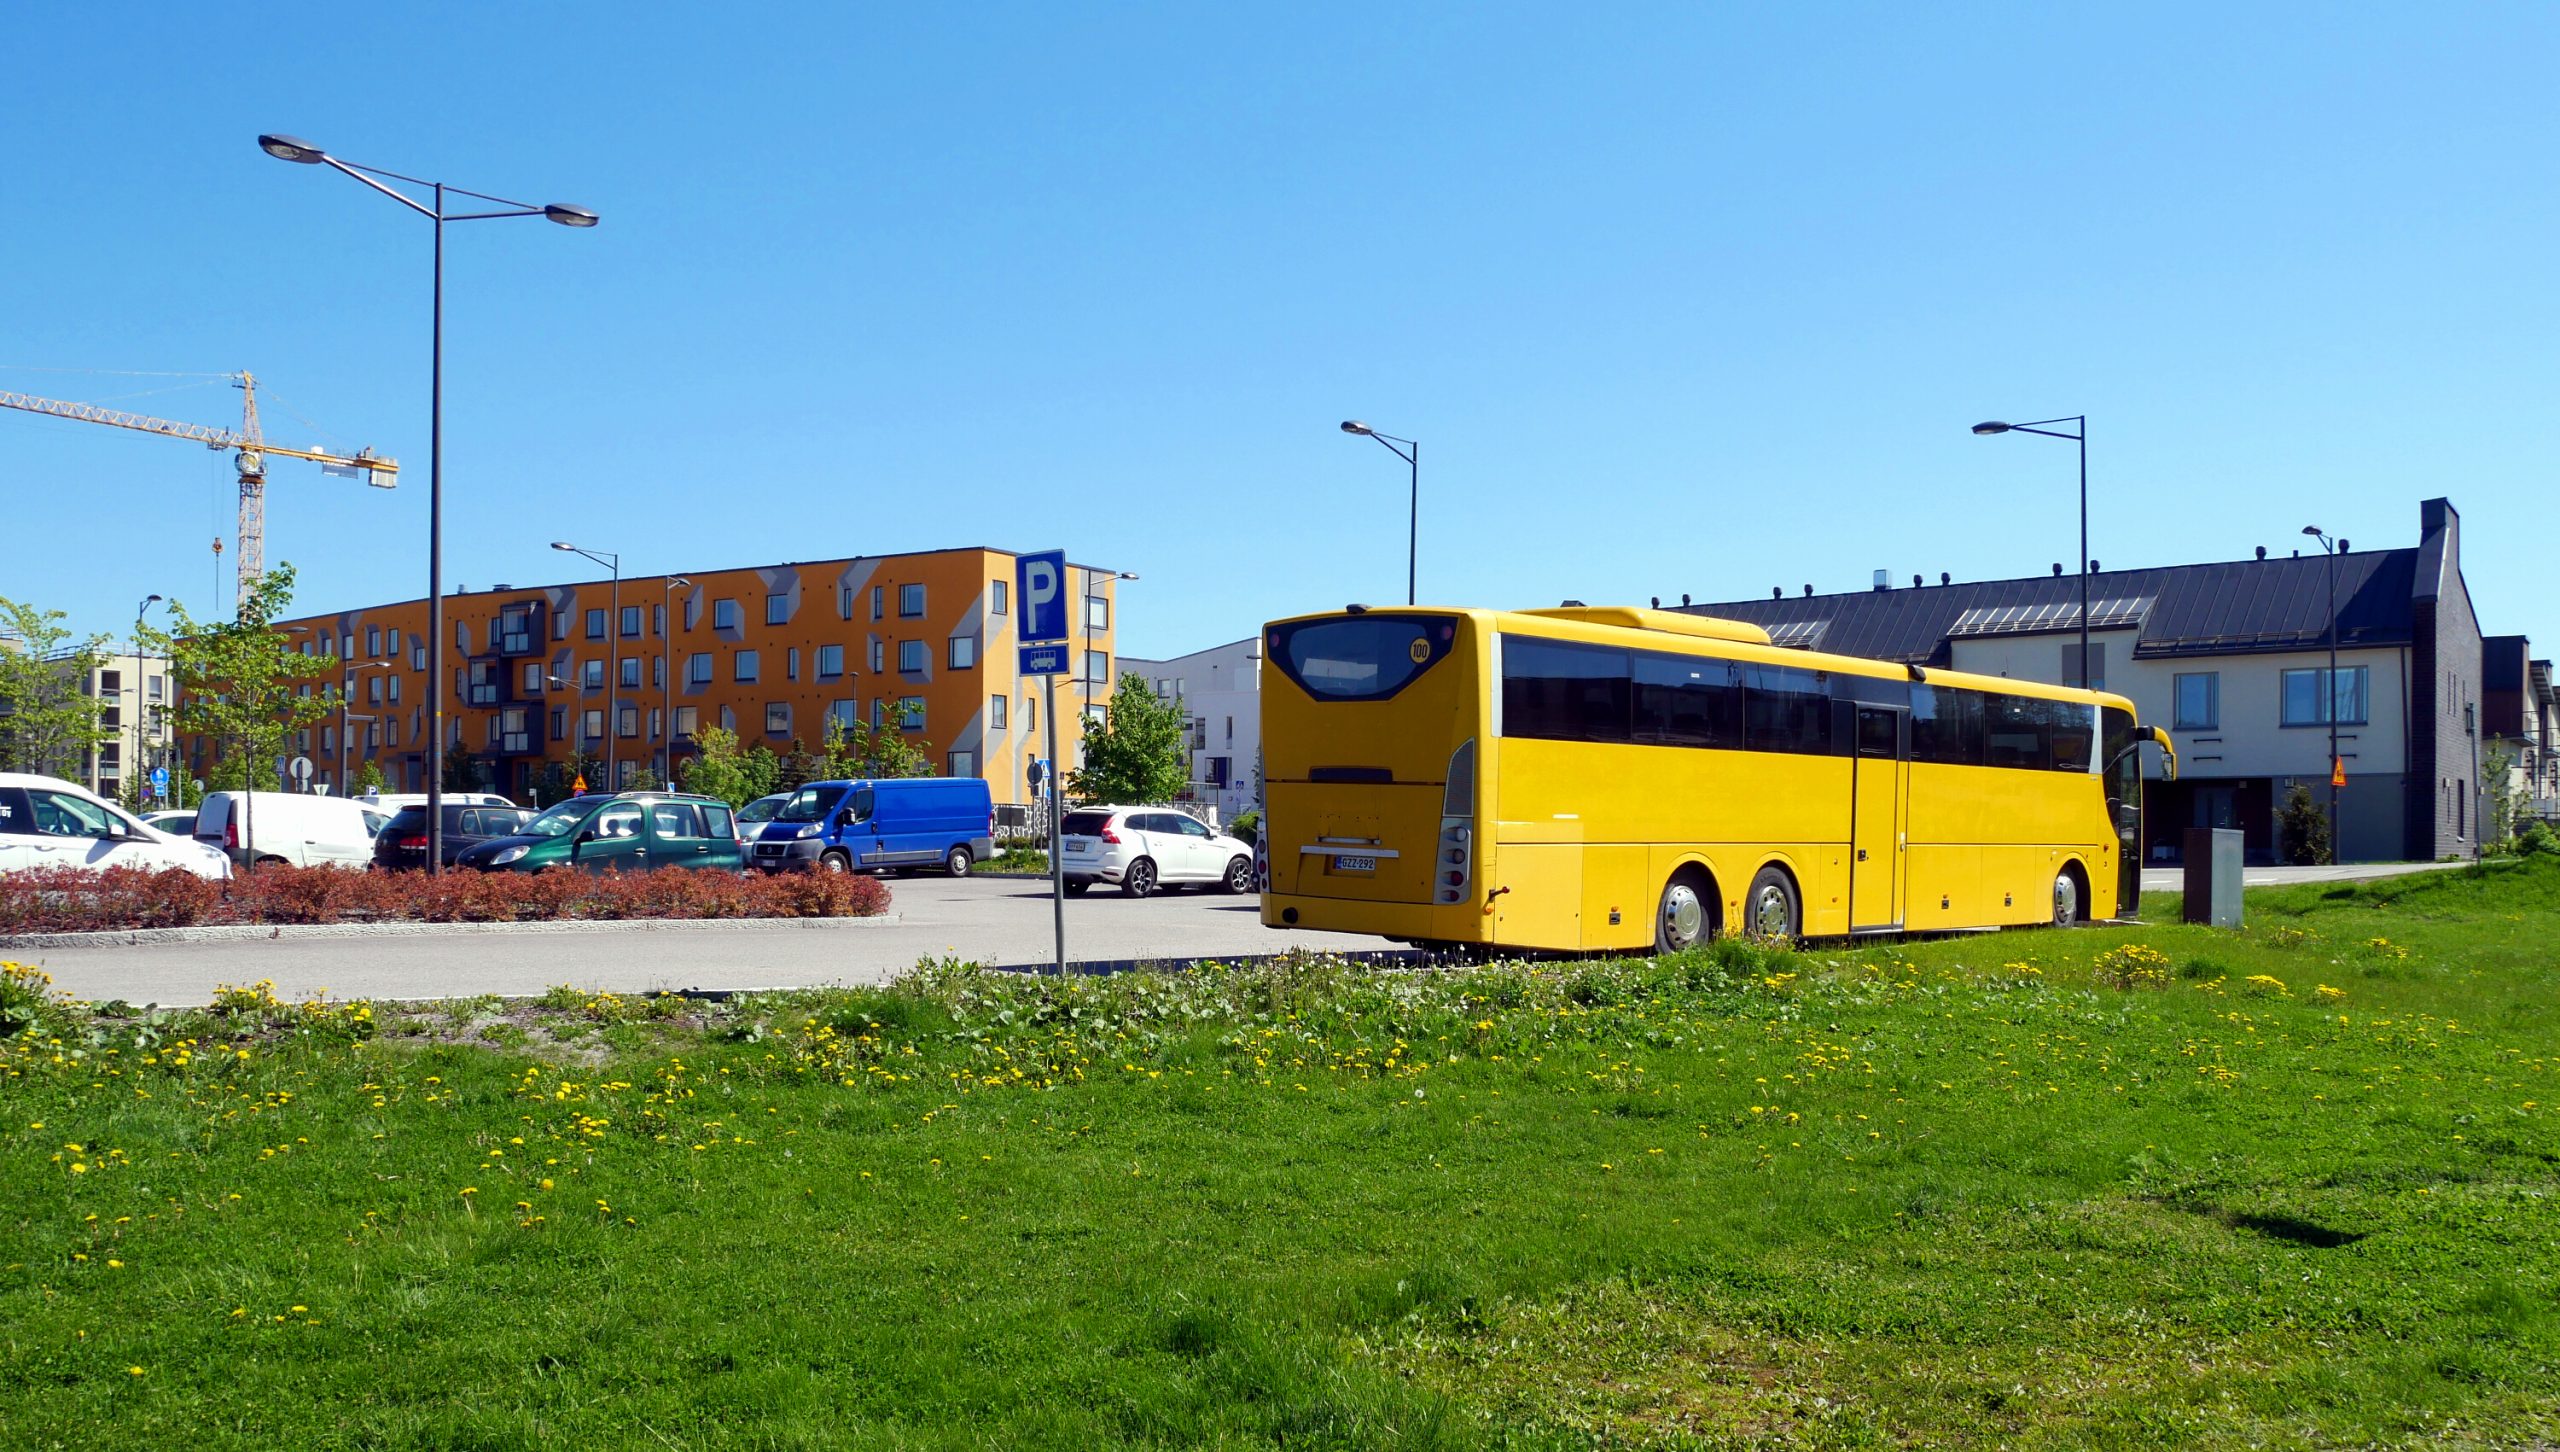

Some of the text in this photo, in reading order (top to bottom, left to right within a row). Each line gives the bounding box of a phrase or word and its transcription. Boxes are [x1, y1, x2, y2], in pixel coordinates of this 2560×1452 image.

[1025, 560, 1058, 635] P
[1413, 643, 1428, 658] 100
[368, 786, 378, 796] P
[1342, 857, 1374, 869] GZZ-292
